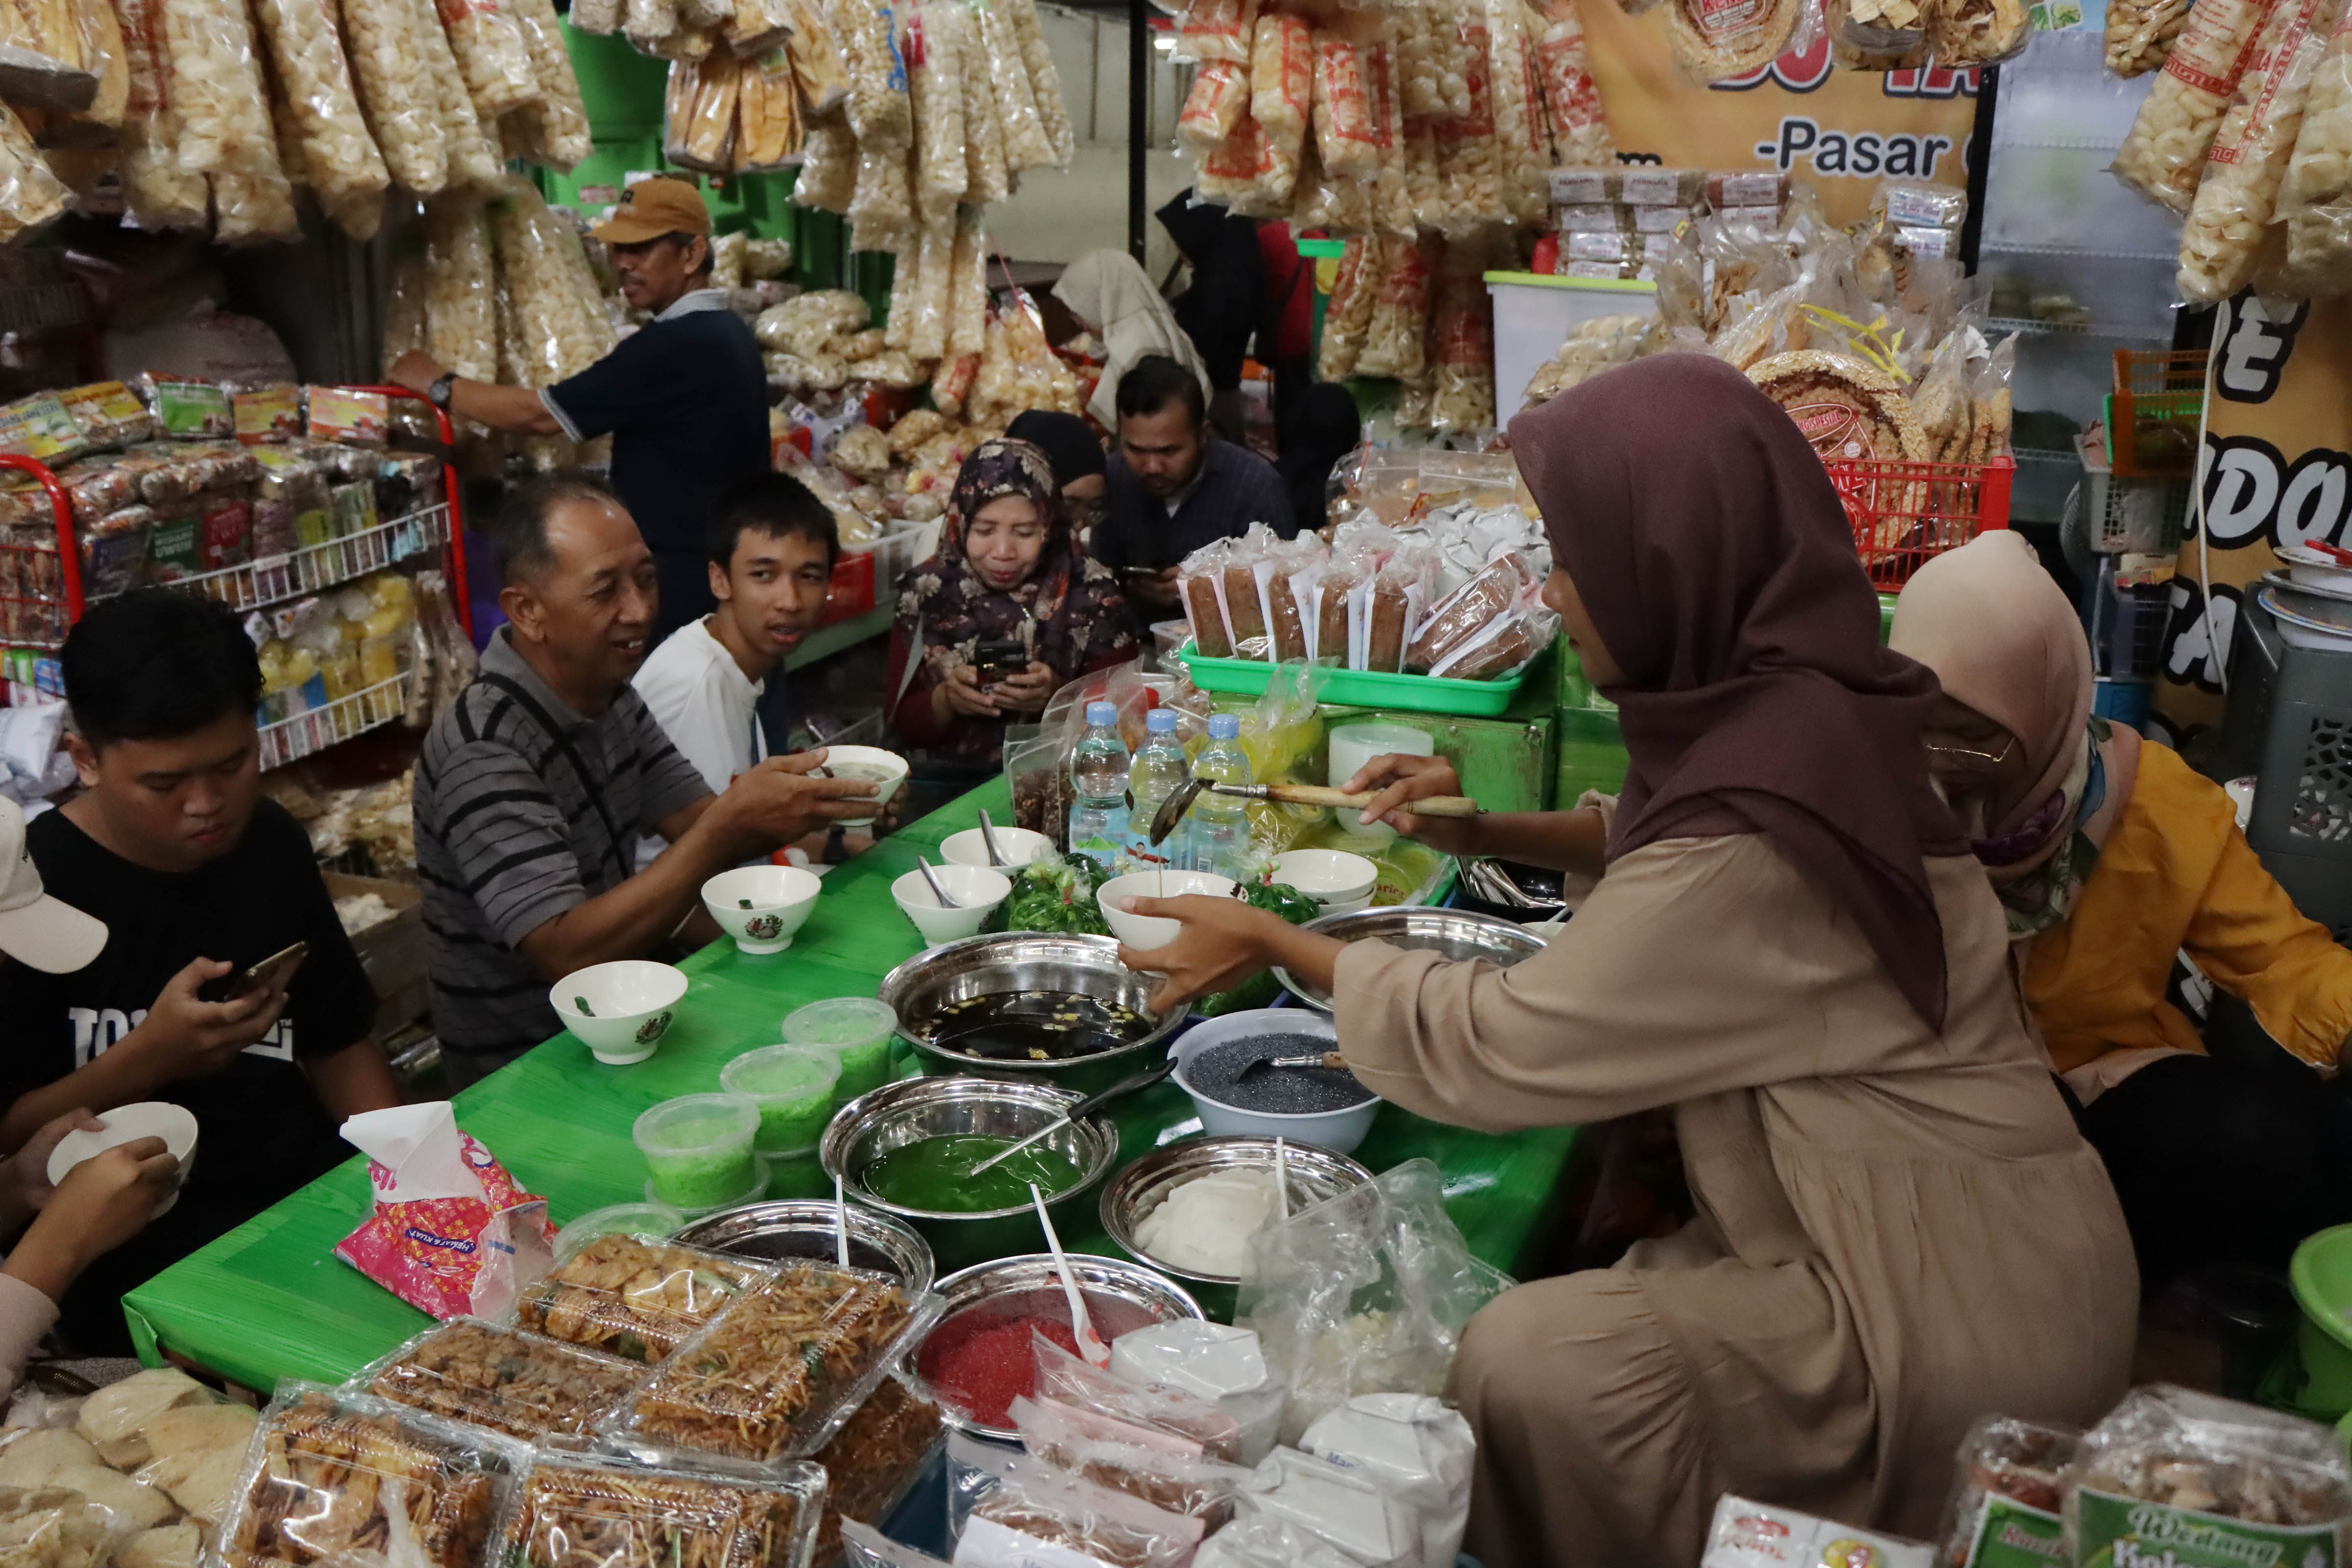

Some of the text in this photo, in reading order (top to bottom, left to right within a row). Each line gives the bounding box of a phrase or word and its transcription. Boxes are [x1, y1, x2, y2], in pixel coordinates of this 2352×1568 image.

[1757, 120, 1949, 176] -Pasar
[1811, 409, 1842, 431] SPESIAL
[2184, 444, 2352, 547] DO
[411, 1229, 434, 1244] KUAT
[440, 1239, 470, 1252] HEMAT
